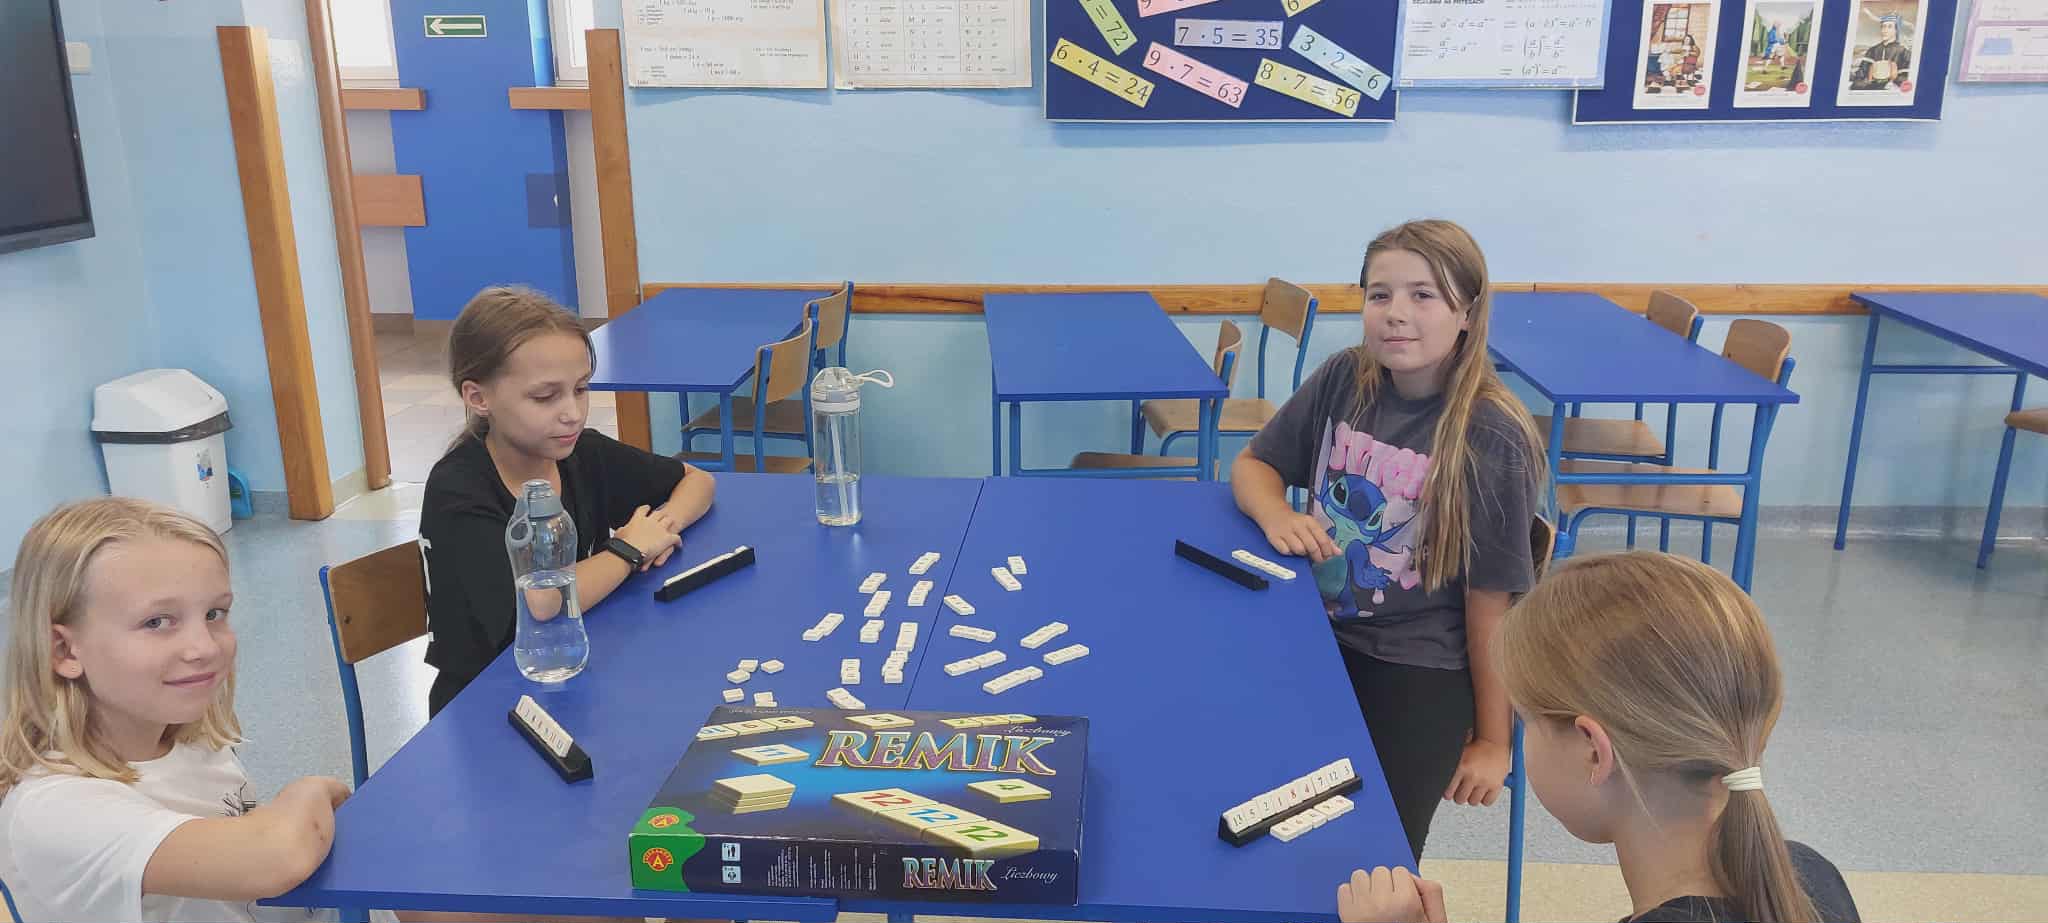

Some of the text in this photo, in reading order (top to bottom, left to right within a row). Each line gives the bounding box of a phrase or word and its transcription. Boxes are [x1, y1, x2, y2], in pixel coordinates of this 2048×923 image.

[1106, 20, 1129, 46] 72
[1178, 26, 1190, 43] 7
[1212, 28, 1224, 45] 5
[1255, 28, 1280, 46] 35
[1056, 44, 1069, 60] 6
[1088, 60, 1100, 76] 4
[1124, 77, 1150, 101] 24
[1149, 50, 1161, 66] 9
[1179, 64, 1194, 80] 7
[1217, 82, 1243, 104] 63
[1300, 34, 1316, 52] 3
[1330, 51, 1345, 69] 2
[1367, 73, 1383, 90] 6
[1260, 63, 1274, 80] 8
[1292, 74, 1306, 90] 7
[1332, 88, 1361, 110] 56
[815, 730, 1057, 776] REMIK
[1290, 789, 1297, 799] 8
[1329, 771, 1338, 780] 12
[863, 792, 1009, 842] 12 12 12
[653, 856, 665, 867] A
[902, 857, 998, 891] REMIK
[1000, 866, 1059, 884] Liczbowy
